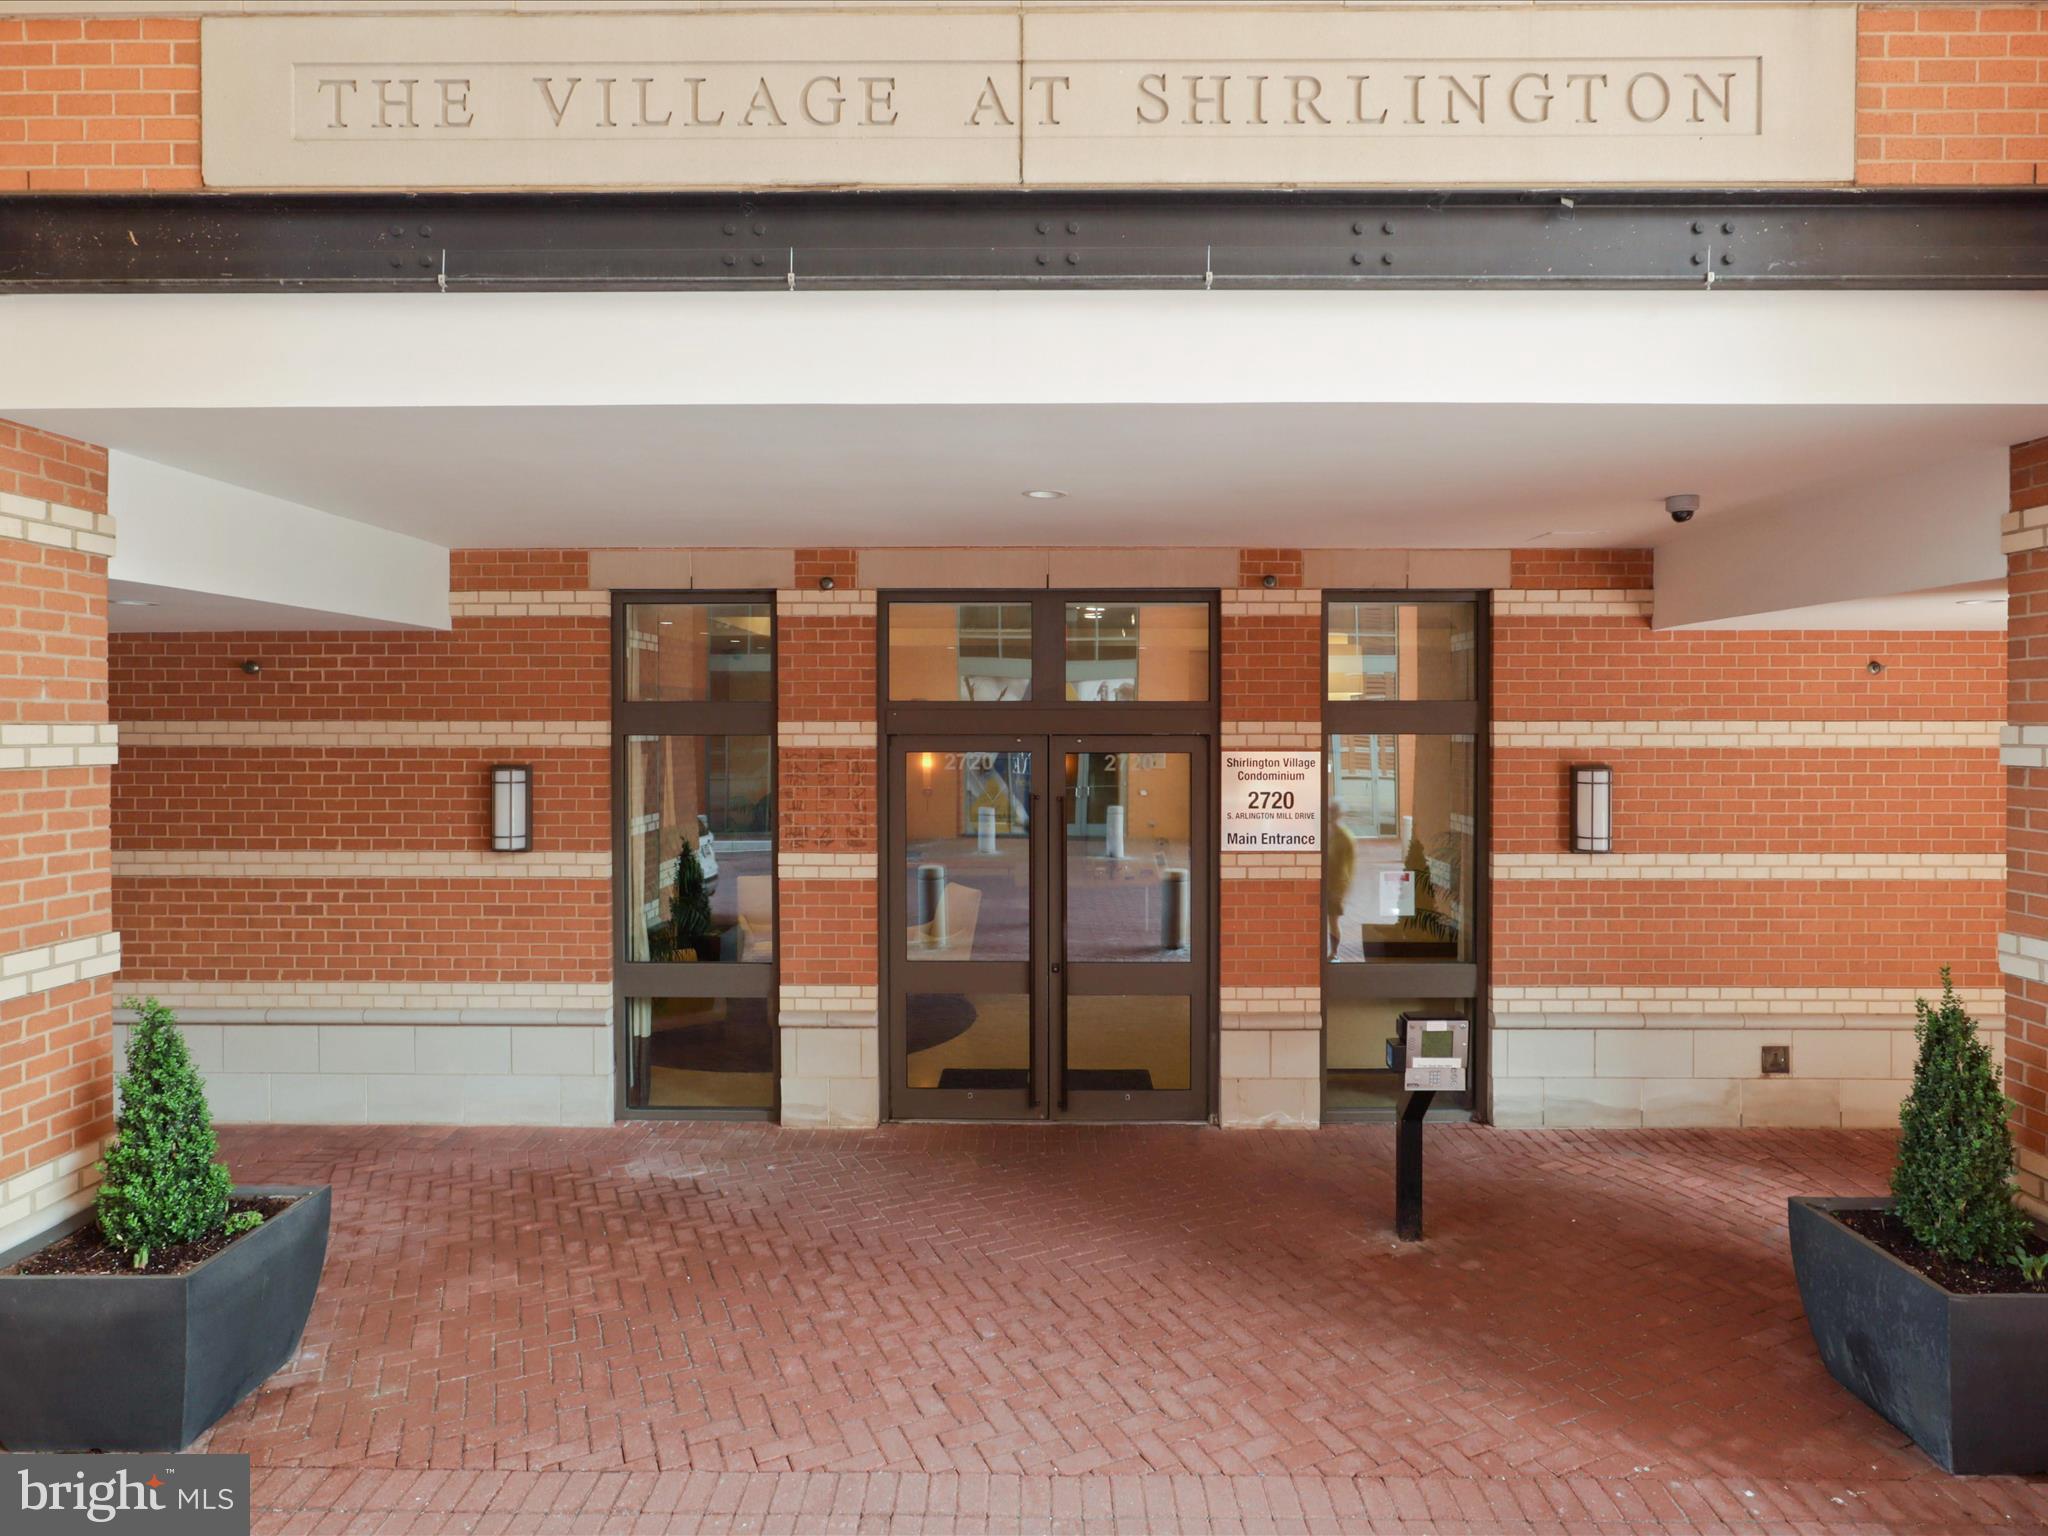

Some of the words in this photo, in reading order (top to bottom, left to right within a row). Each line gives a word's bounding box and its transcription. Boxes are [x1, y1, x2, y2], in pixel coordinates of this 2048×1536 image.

[318, 78, 475, 128] THE
[532, 76, 899, 127] VILLAGE
[963, 75, 1069, 126] AT
[1136, 73, 1736, 126] SHIRLINGTON
[944, 753, 992, 770] 2720
[1226, 757, 1280, 770] Shirlington
[1283, 757, 1316, 770] Village
[1237, 771, 1305, 781] Condominium
[1248, 791, 1295, 810] 2720
[1226, 812, 1234, 820] S.
[1236, 812, 1275, 820] ARLINGTON
[1276, 812, 1293, 820] MILL
[1295, 812, 1315, 820] DRIVE
[1227, 832, 1257, 845] Main
[1261, 832, 1316, 845] Entrance
